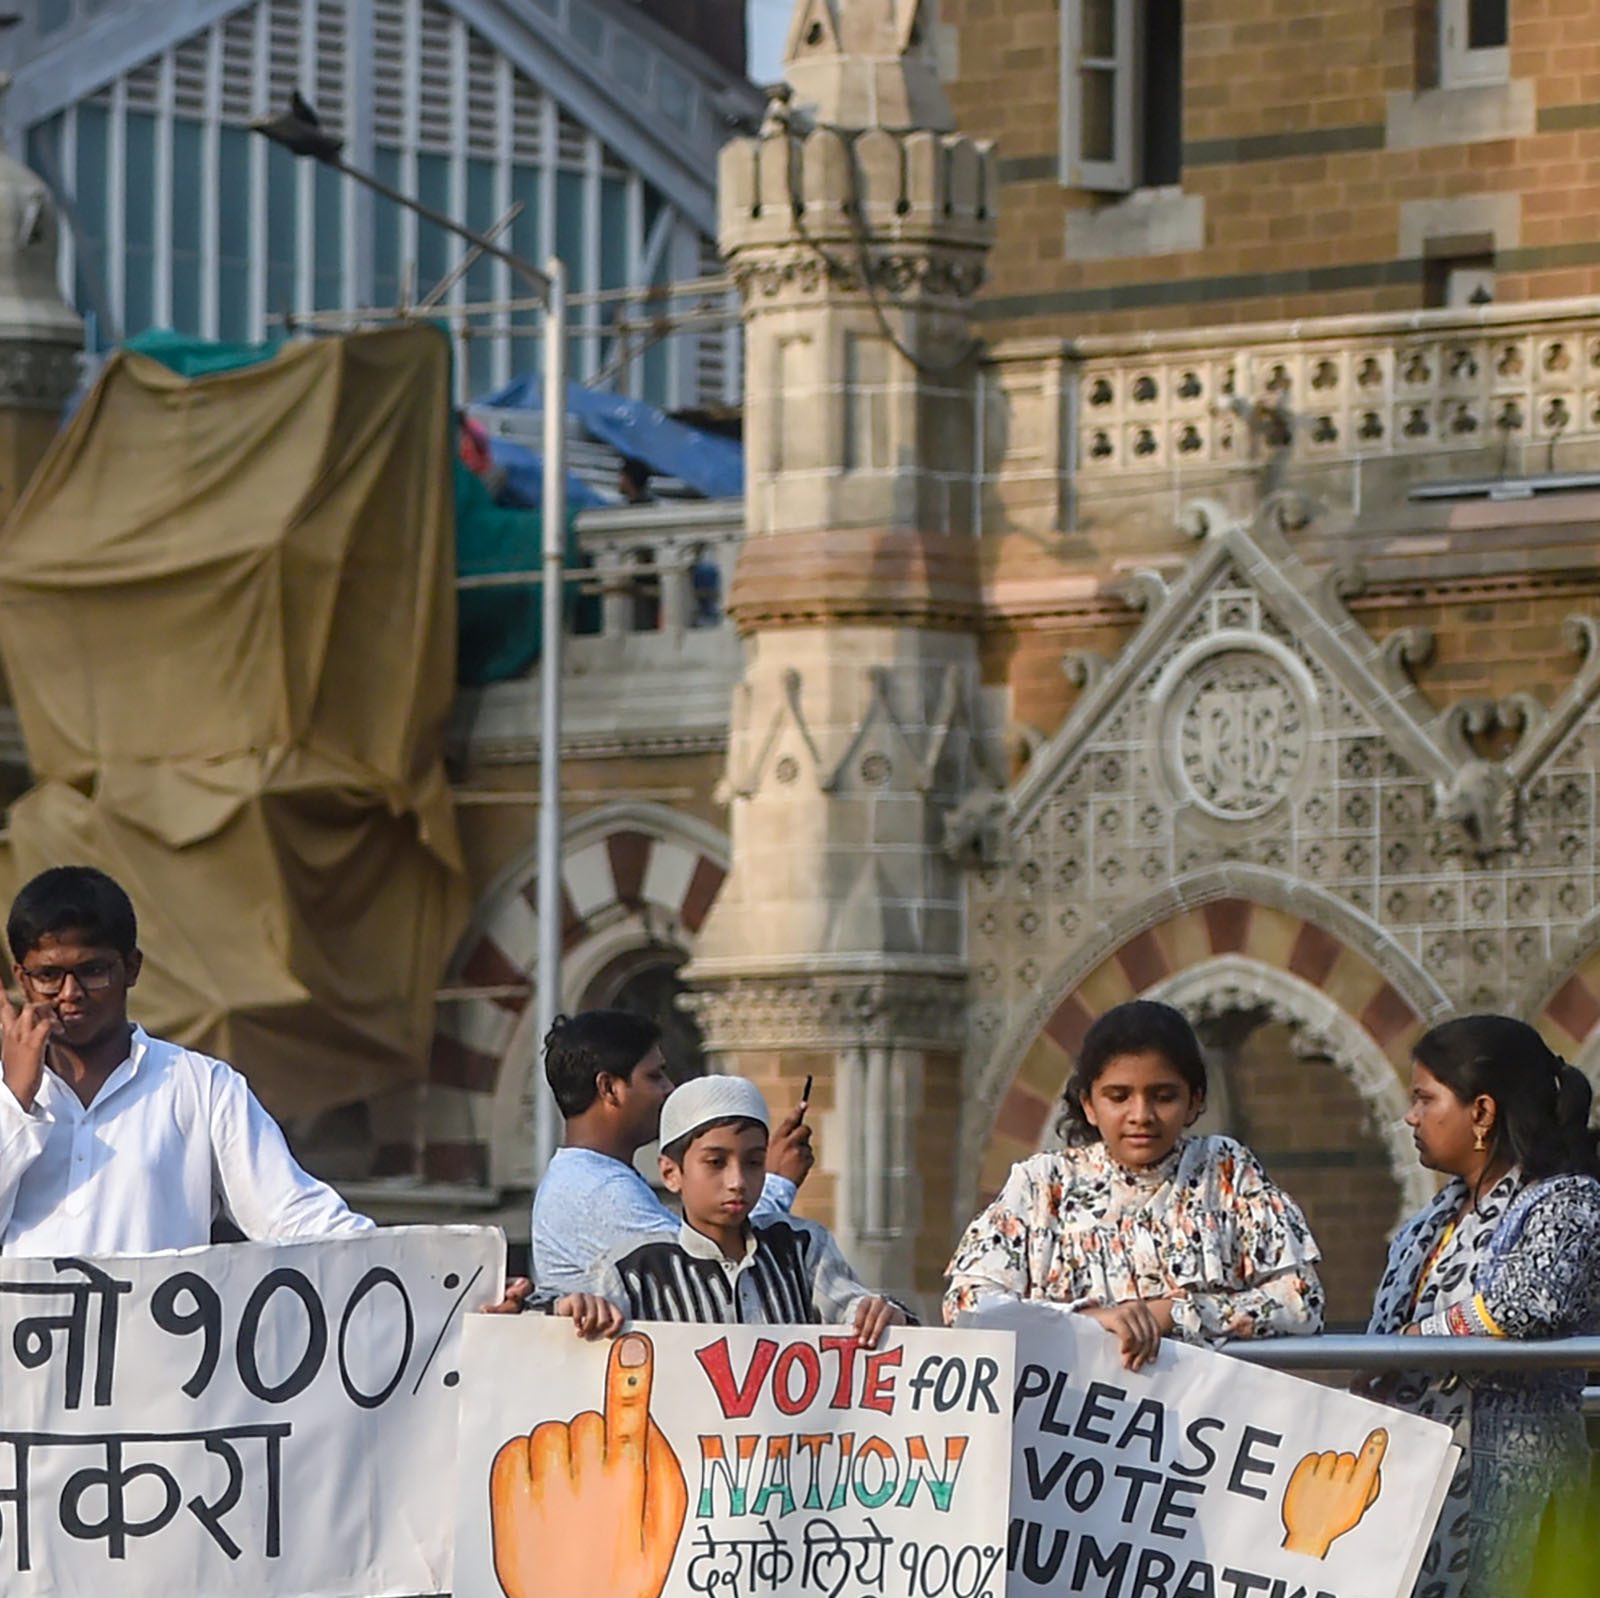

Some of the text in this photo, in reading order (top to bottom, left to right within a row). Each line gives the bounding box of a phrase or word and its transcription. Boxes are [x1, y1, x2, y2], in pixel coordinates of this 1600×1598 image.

[694, 1335, 905, 1420] VOTE
[695, 1431, 970, 1519] NATION
[1012, 1363, 1283, 1501] PLEASE
[1023, 1446, 1207, 1540] VOTE
